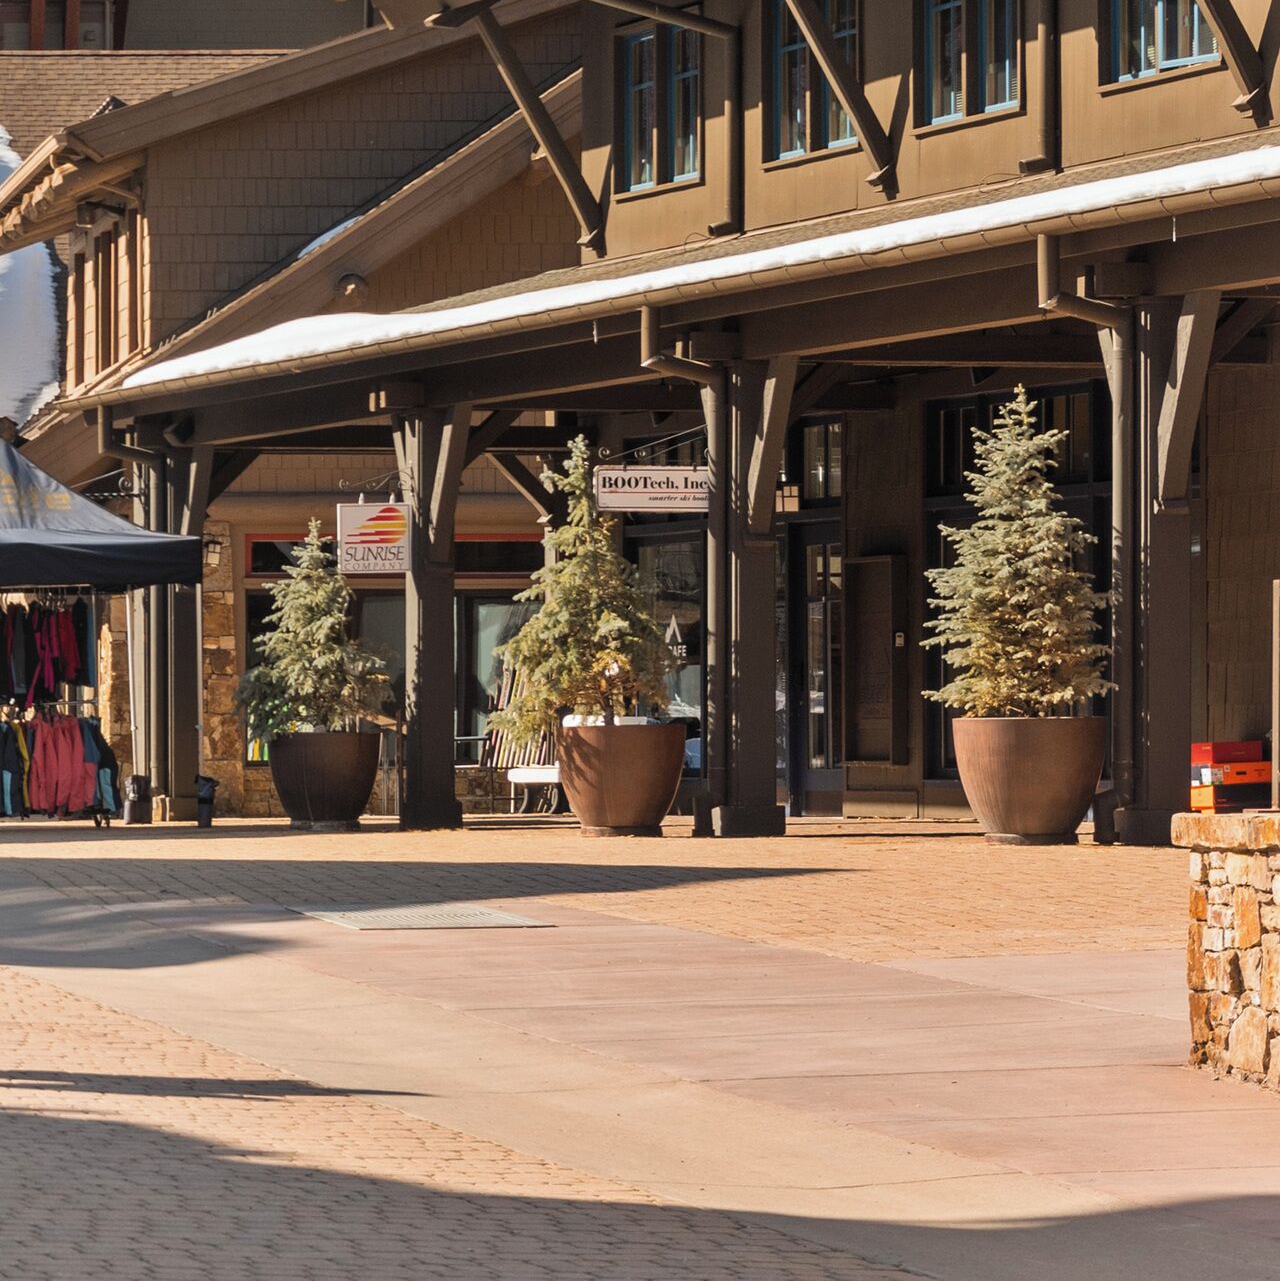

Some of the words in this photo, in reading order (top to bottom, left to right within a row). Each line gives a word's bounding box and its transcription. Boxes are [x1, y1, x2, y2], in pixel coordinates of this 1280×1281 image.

[602, 476, 679, 490] BOOTech,
[344, 546, 405, 562] SUNRISE
[344, 562, 405, 570] COMPANY
